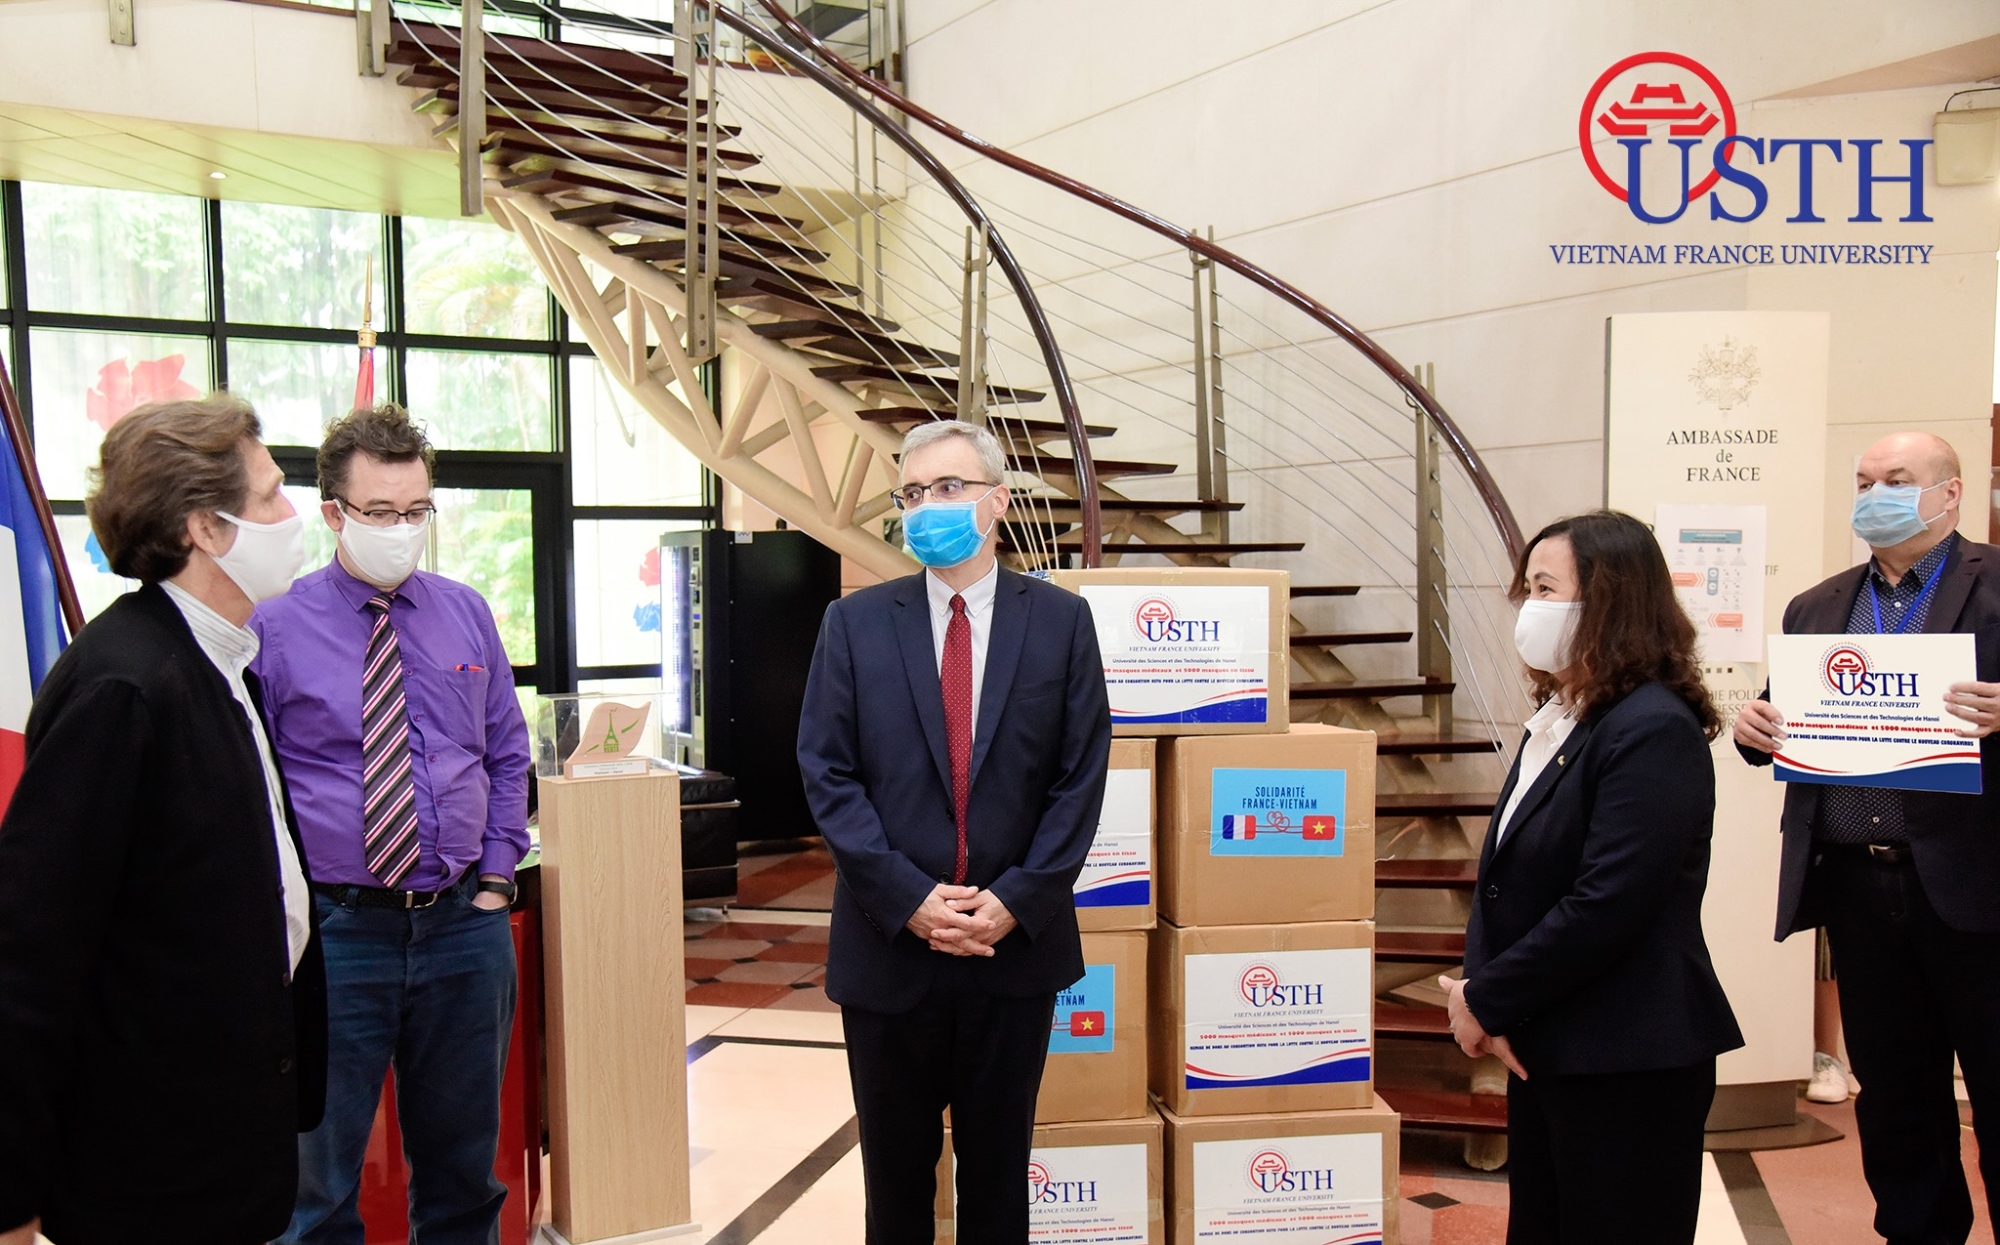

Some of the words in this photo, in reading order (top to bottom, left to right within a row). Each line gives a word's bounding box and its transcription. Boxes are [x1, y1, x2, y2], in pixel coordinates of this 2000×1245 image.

[1666, 430, 1778, 445] AMBASSADE
[1716, 449, 1733, 463] de
[1686, 467, 1761, 482] FRANCE
[1146, 620, 1220, 642] USTH
[1837, 672, 1919, 697] USTH
[1256, 785, 1305, 797] SOLIDARITÉ
[1242, 798, 1317, 809] FRANCE-VIETNAM
[1251, 983, 1323, 1008] USTH
[1261, 1169, 1333, 1193] USTH
